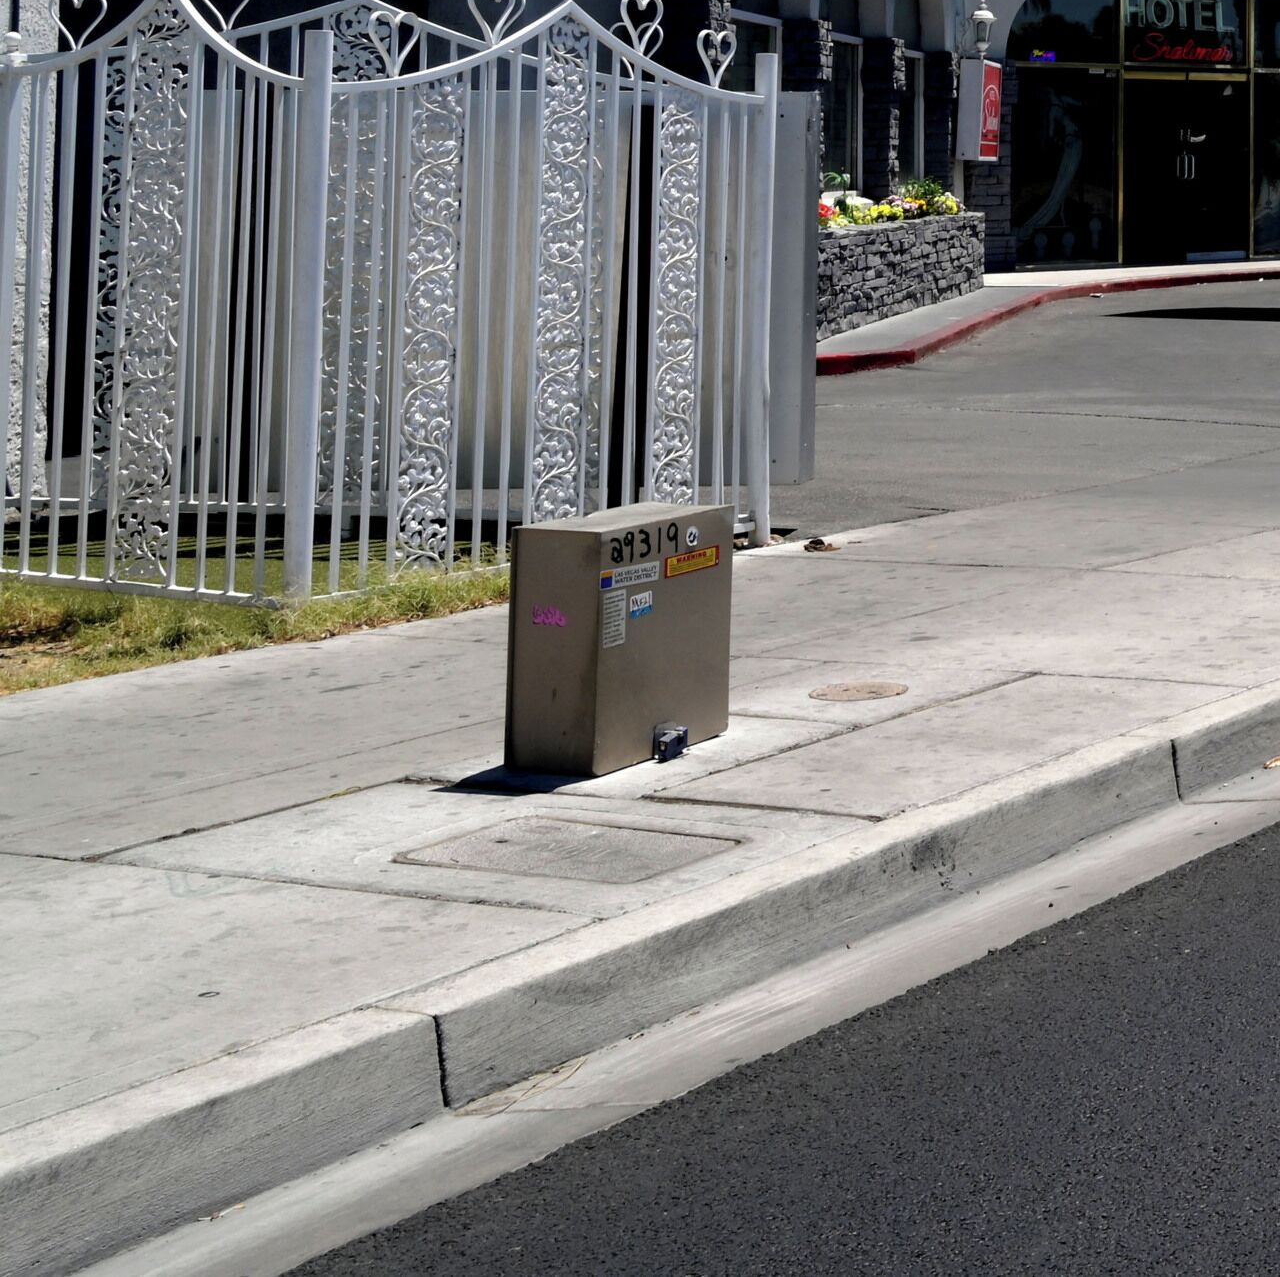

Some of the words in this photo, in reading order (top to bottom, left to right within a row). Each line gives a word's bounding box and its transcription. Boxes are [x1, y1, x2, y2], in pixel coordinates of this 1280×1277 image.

[610, 522, 679, 563] 29319
[676, 550, 708, 563] WARNING
[615, 576, 632, 584] WATER
